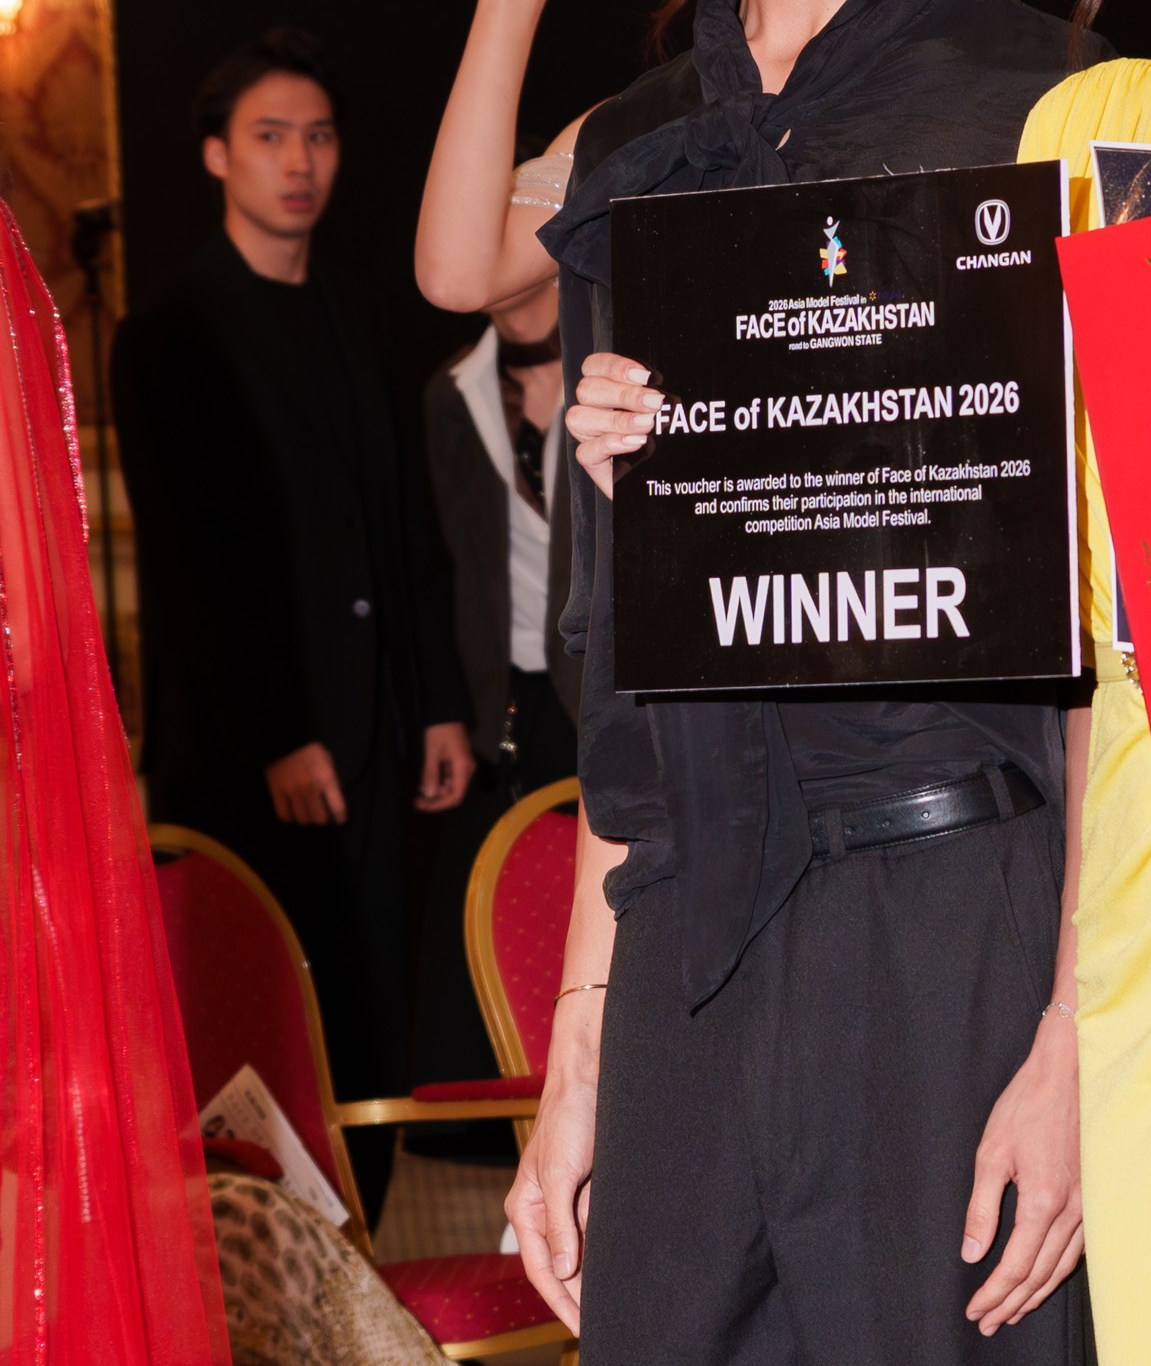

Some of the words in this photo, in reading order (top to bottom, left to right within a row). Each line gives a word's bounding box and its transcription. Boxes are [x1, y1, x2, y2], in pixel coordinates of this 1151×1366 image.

[956, 250, 1032, 271] CHANGAN
[769, 299, 787, 311] 2026
[789, 299, 805, 309] Asia
[806, 297, 829, 308] Model
[831, 294, 859, 306] Festival
[736, 313, 786, 339] FACE
[788, 311, 805, 336] of
[808, 301, 935, 334] KAZAKHSTAN
[810, 336, 854, 349] GANGWON
[855, 334, 882, 346] STATE
[656, 400, 725, 434] FACE
[734, 398, 760, 429] of
[768, 386, 952, 428] KAZAKHSTAN
[959, 381, 1019, 415] 2026
[647, 481, 671, 496] This
[674, 477, 721, 494] voucher
[724, 477, 733, 492] is
[736, 474, 786, 491] awarded
[789, 474, 801, 488] to
[804, 471, 822, 488] the
[826, 470, 864, 486] winner
[868, 468, 880, 484] of
[882, 467, 911, 483] Face
[915, 465, 927, 482] of
[929, 462, 997, 480] Kazakhstan
[1001, 460, 1031, 477] 2026
[695, 498, 717, 514] and
[720, 495, 769, 513] confirms
[772, 494, 798, 511] their
[801, 491, 872, 513] participation
[875, 490, 885, 505] in
[888, 489, 907, 504] the
[910, 485, 982, 503] international
[746, 516, 811, 535] competition
[814, 514, 840, 530] Asia
[843, 512, 879, 528] Model
[882, 509, 931, 526] Festival.
[709, 566, 971, 647] WINNER
